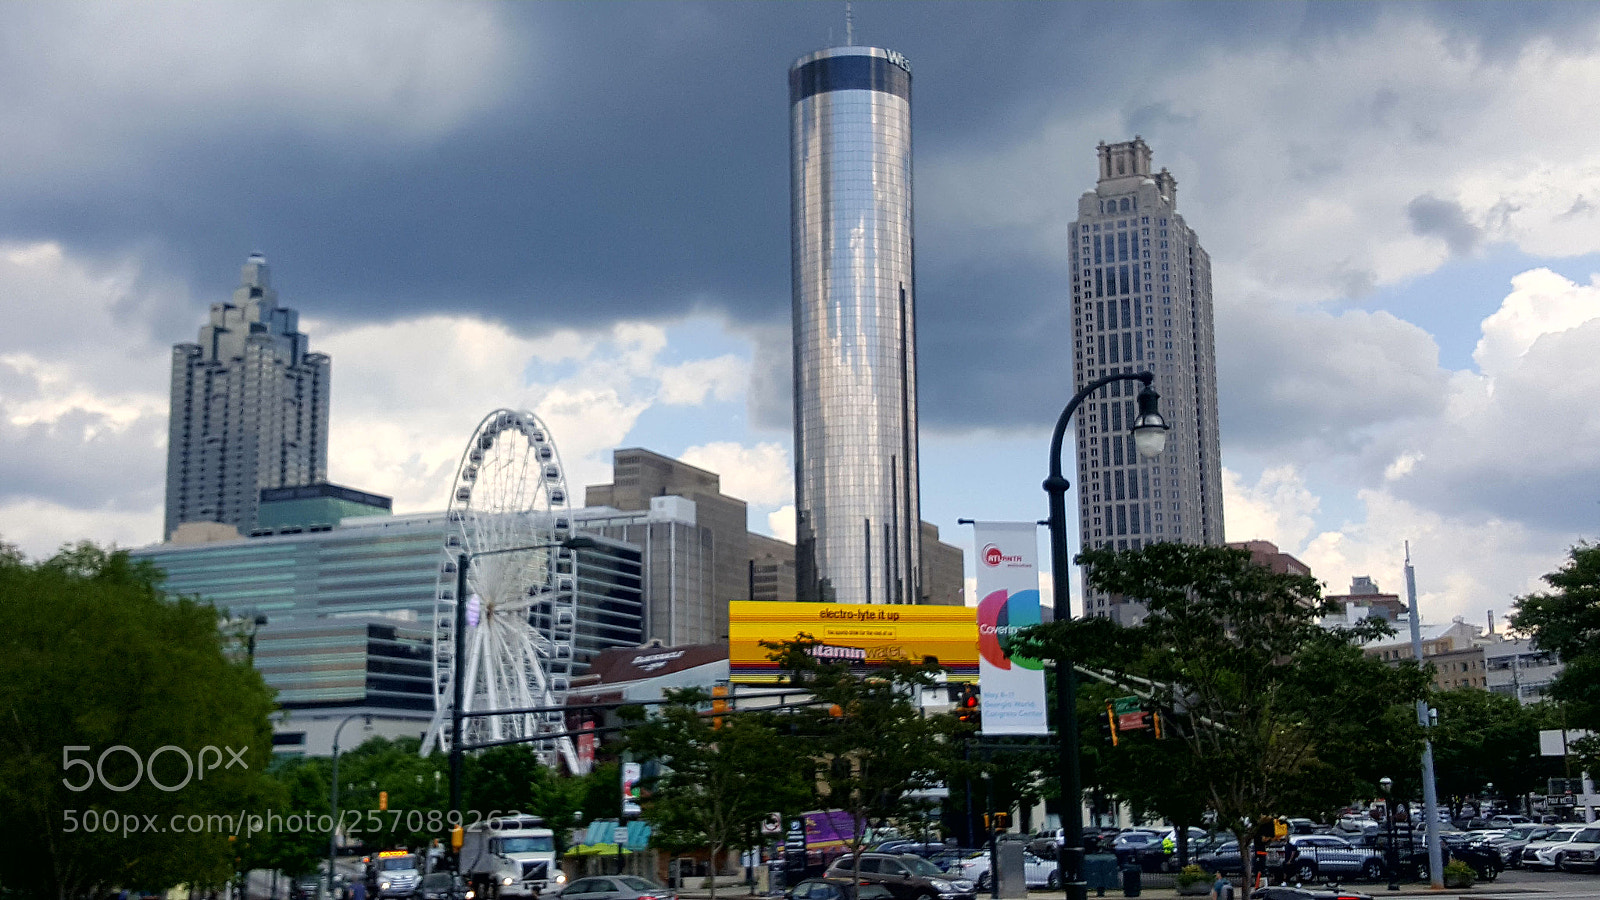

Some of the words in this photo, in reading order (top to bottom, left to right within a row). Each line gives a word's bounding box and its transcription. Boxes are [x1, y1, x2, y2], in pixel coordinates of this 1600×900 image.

[820, 608, 876, 621] electro-lyte
[878, 609, 886, 620] it
[887, 612, 900, 622] up
